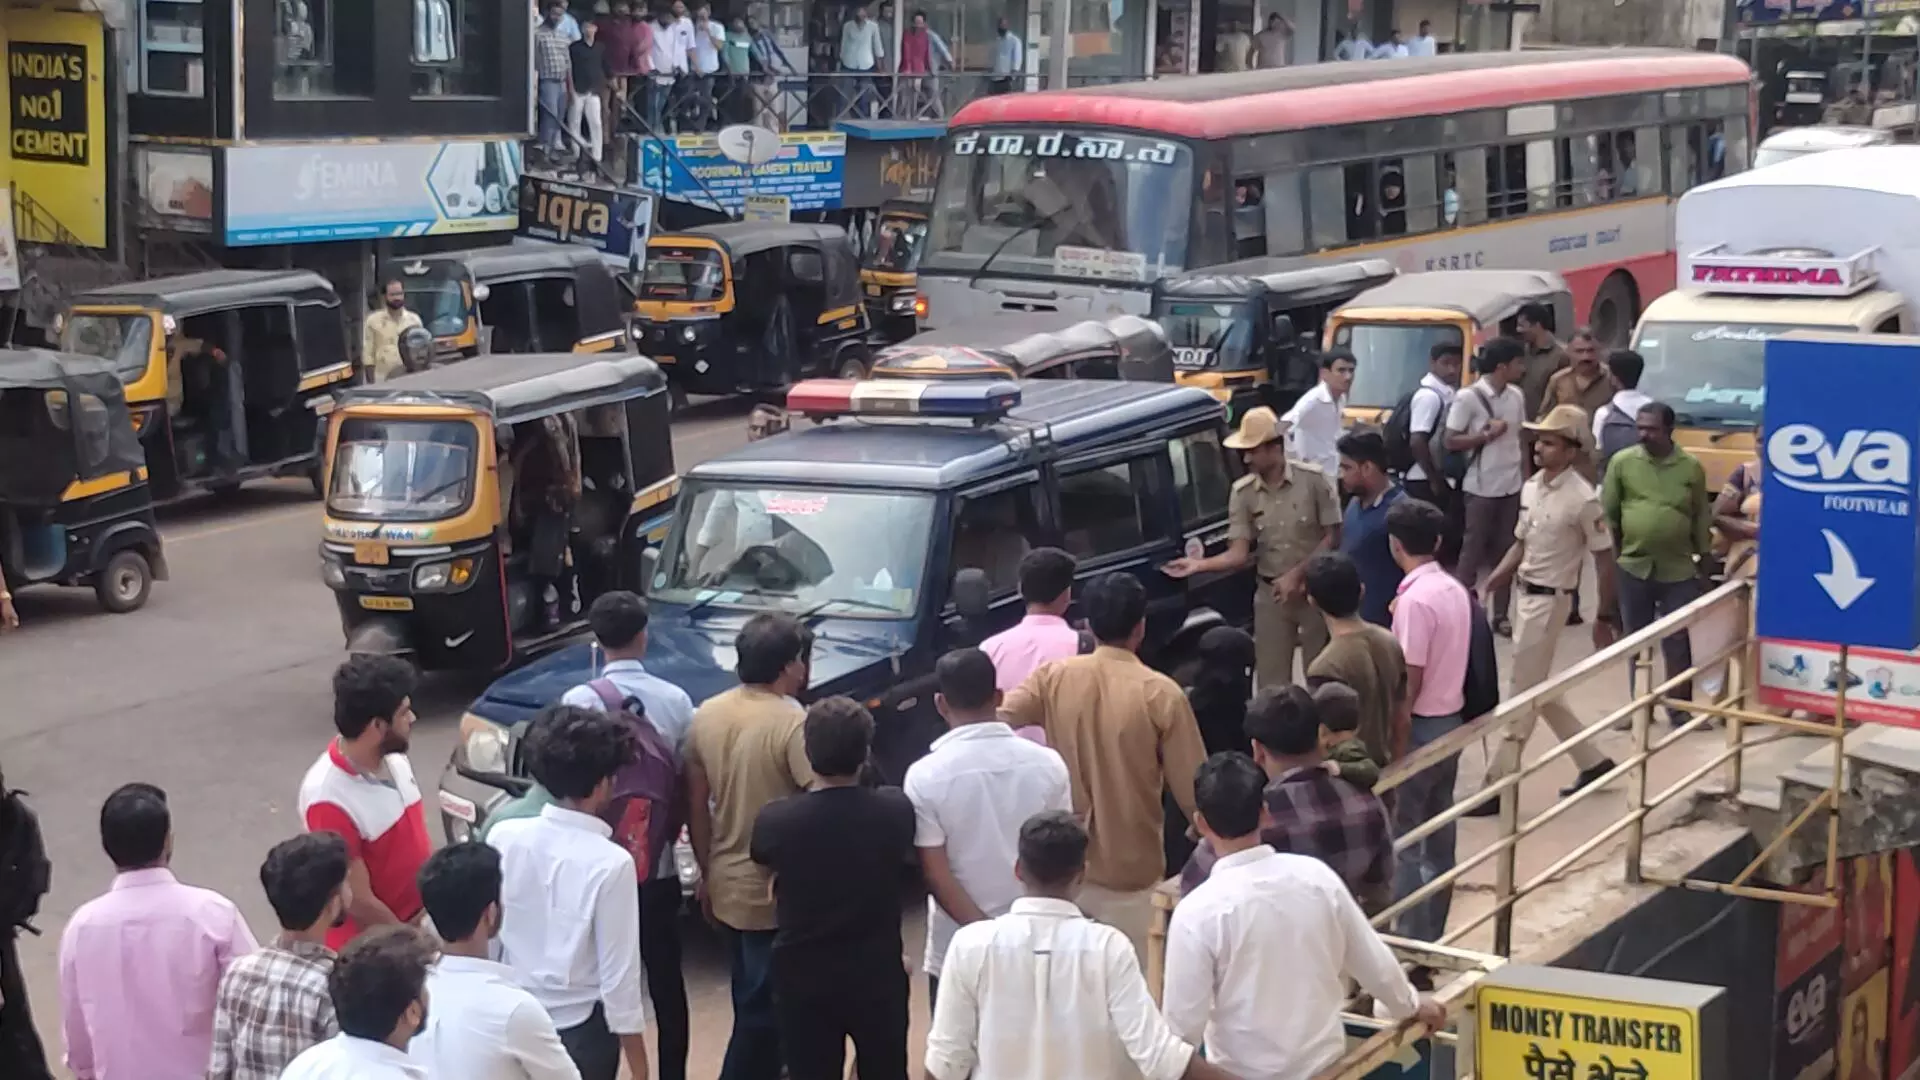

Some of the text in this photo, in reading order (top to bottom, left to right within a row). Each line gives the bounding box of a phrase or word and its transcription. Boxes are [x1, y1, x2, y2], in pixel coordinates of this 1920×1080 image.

[12, 52, 82, 81] INDIA'S
[12, 128, 87, 158] CEMENT
[793, 160, 833, 174] TRAVELS
[1768, 424, 1911, 484] eva
[1823, 495, 1909, 516] FOOTWEAR
[1489, 1002, 1682, 1054] MONEY TRANSFER
